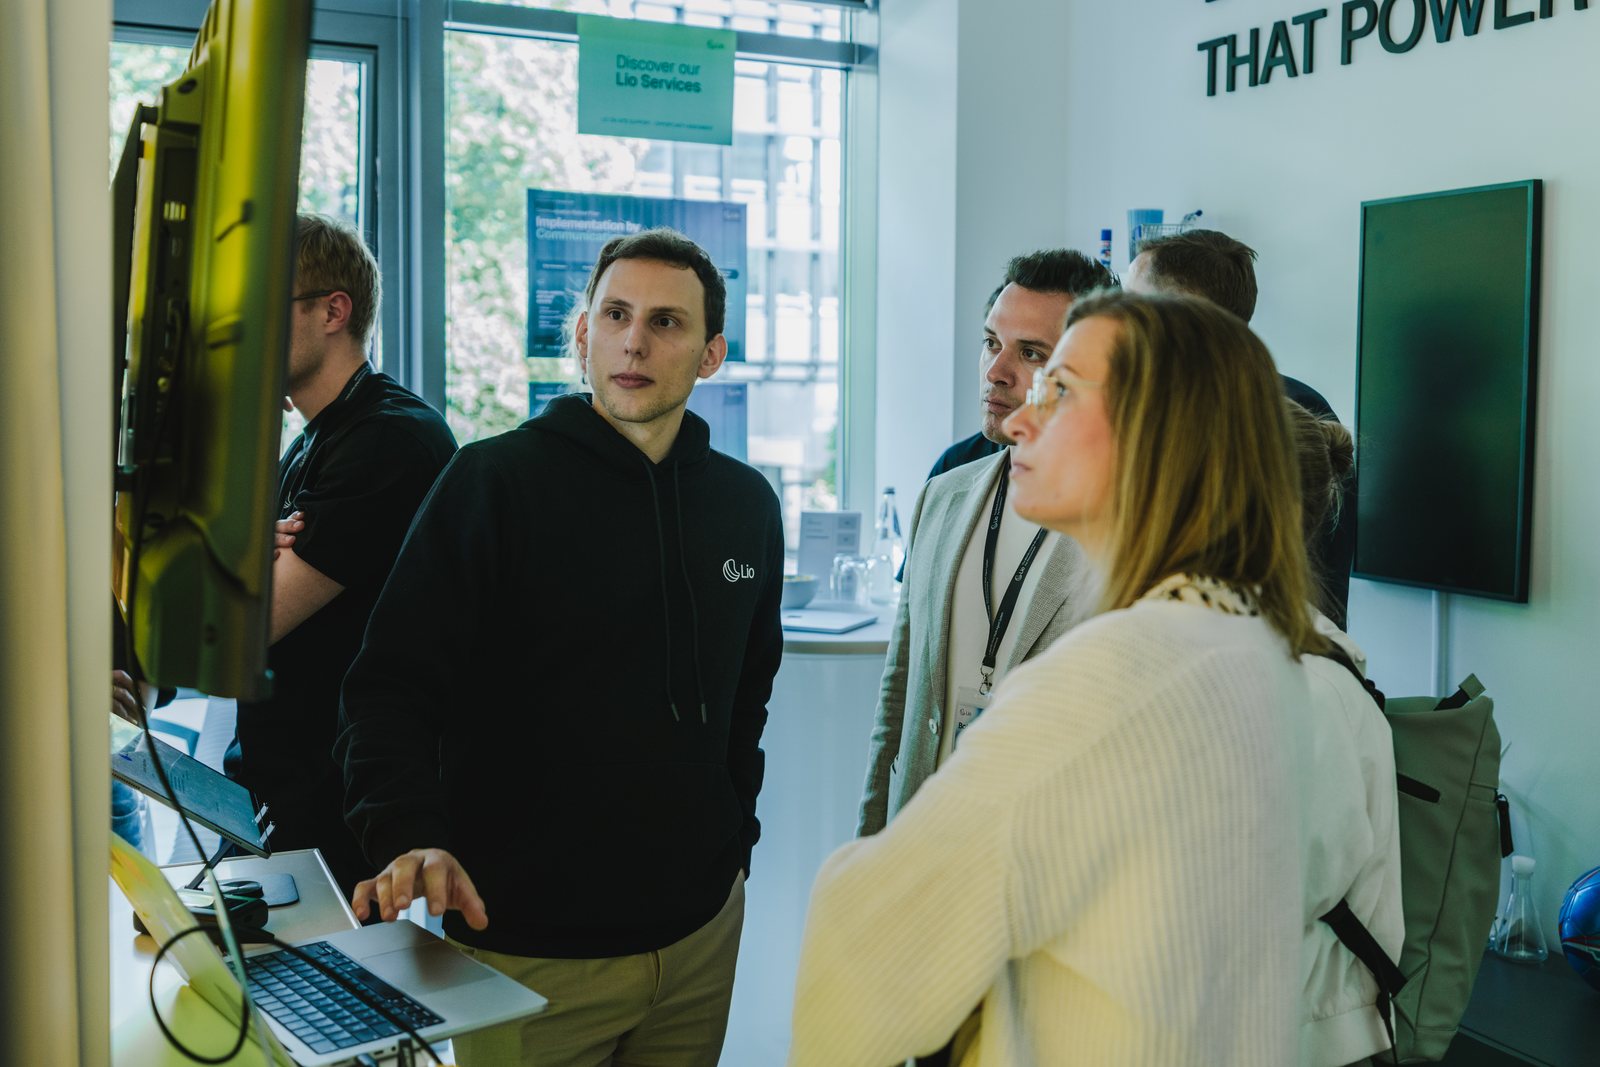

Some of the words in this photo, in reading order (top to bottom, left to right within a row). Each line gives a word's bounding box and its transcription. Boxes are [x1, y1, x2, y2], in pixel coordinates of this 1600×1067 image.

[1197, 8, 1328, 97] THAT
[1341, 0, 1589, 66] POW
[616, 54, 675, 73] Discover
[678, 63, 701, 76] our
[616, 71, 638, 88] Lio
[640, 73, 702, 93] Services
[536, 215, 625, 233] Implementation
[740, 564, 755, 579] Lio
